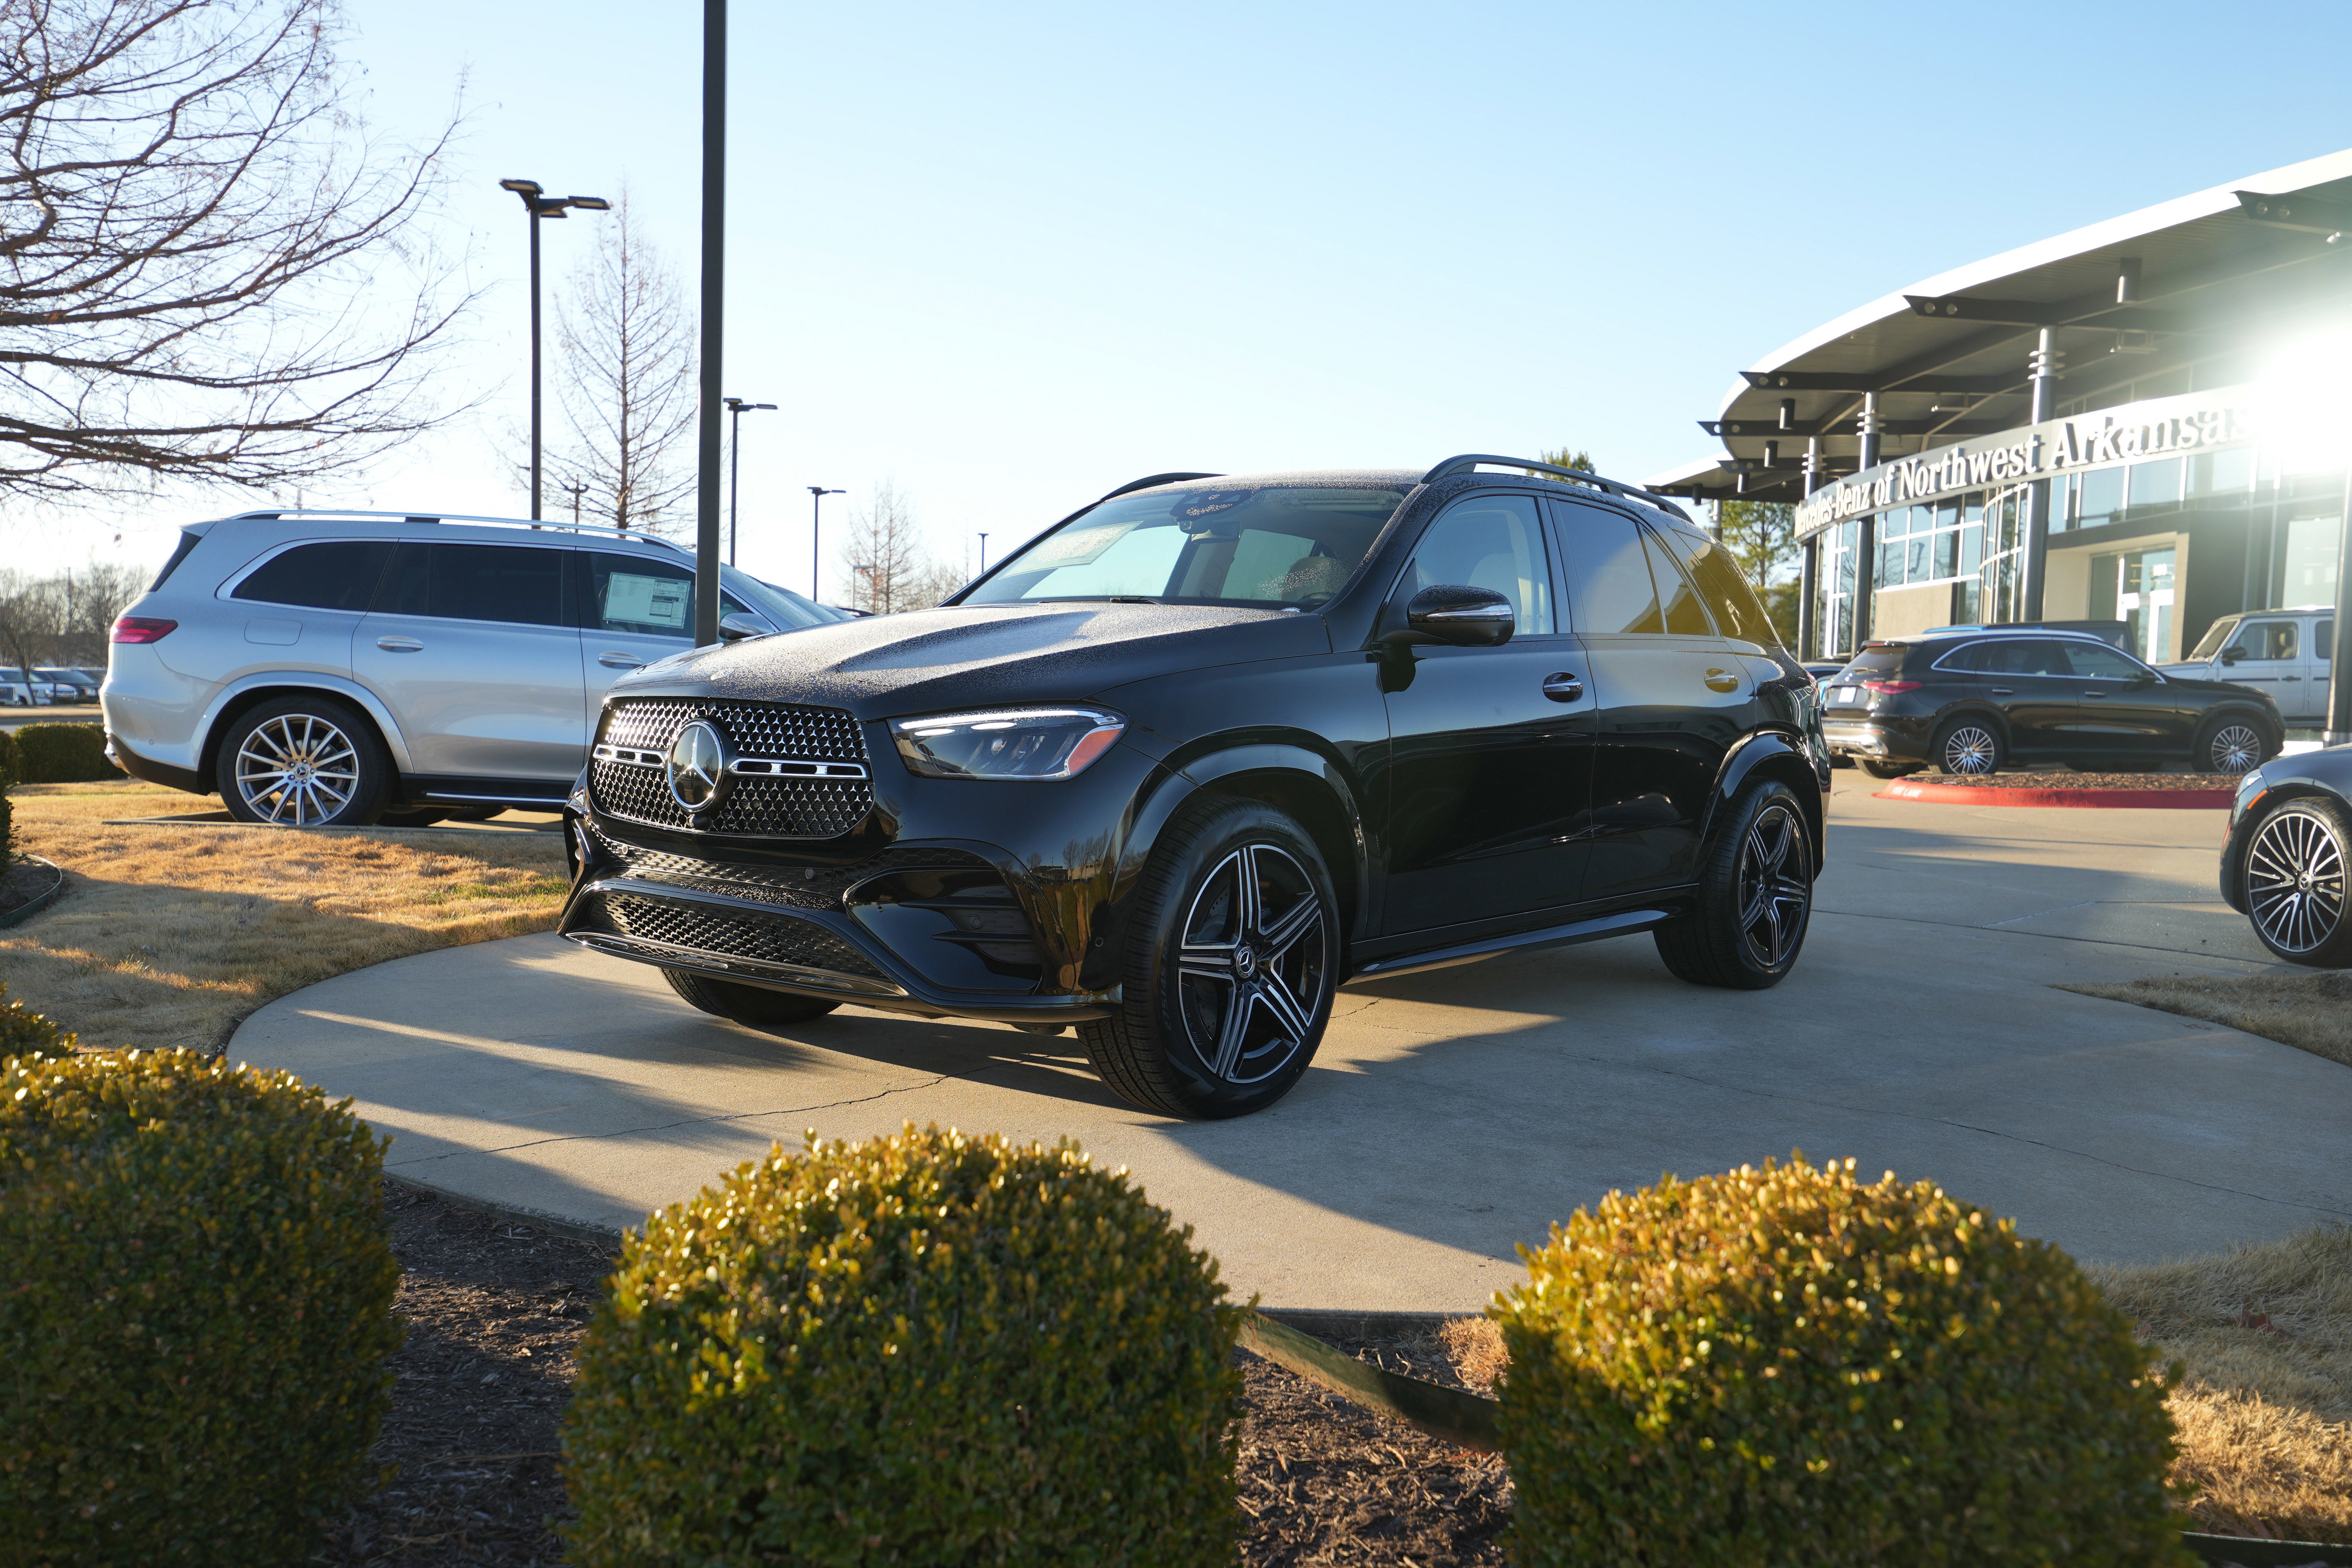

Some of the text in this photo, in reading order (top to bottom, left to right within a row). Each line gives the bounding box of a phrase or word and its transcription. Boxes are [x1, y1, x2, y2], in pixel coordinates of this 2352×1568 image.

[1794, 404, 2254, 539] Mercedes-Benz of Northwest Arkansas
[1258, 816, 1290, 835] PIRELLI
[1160, 964, 1172, 1031] 275/45
